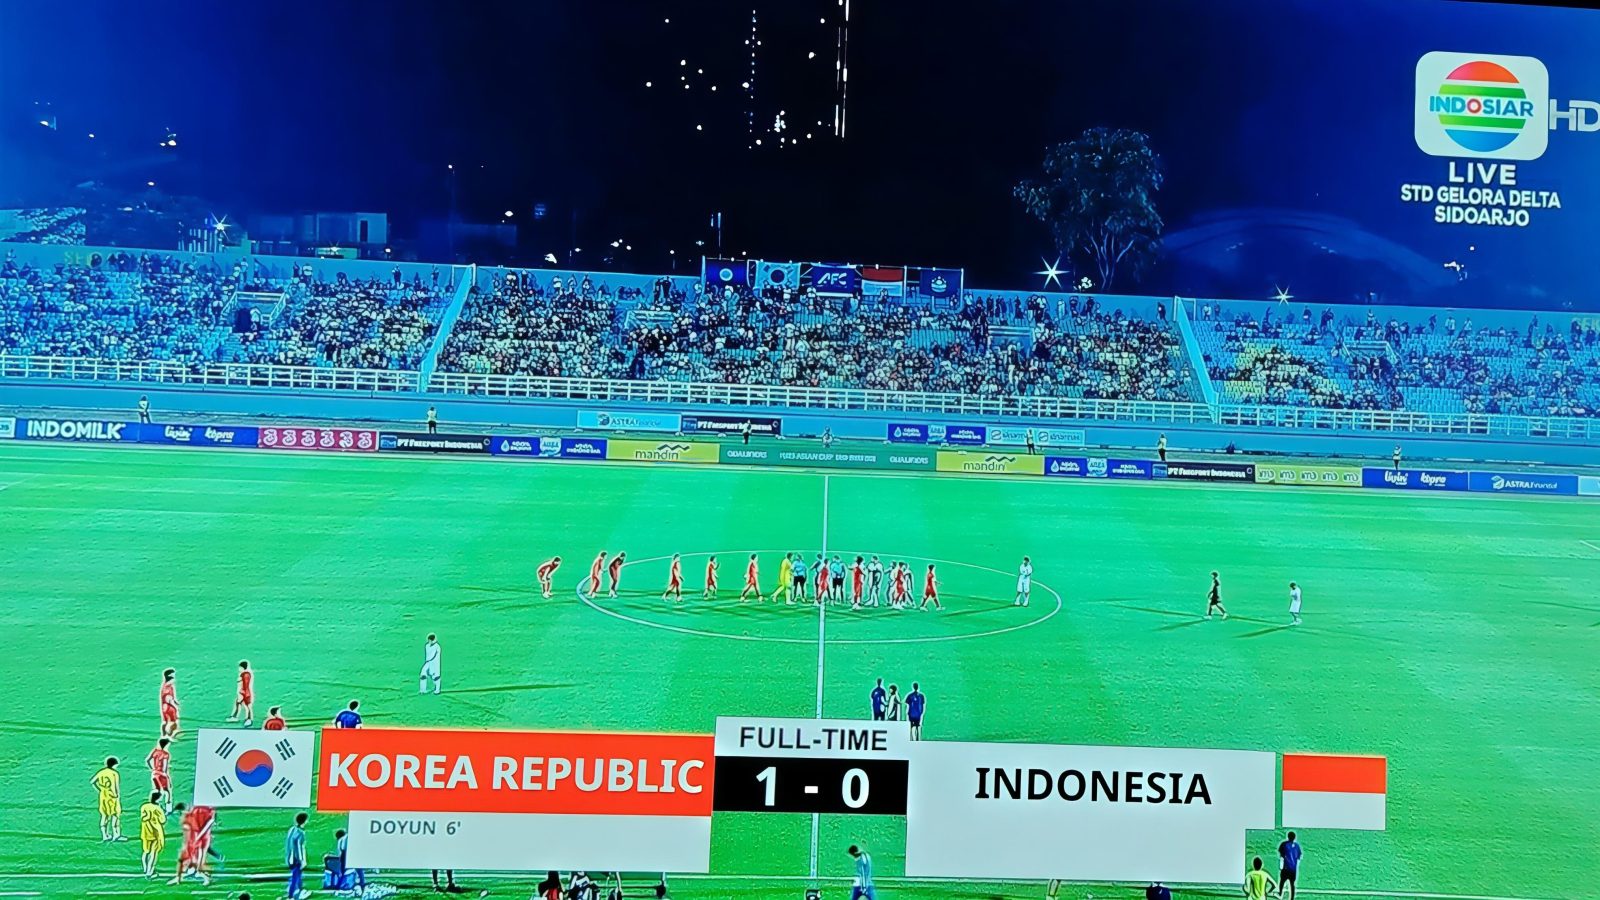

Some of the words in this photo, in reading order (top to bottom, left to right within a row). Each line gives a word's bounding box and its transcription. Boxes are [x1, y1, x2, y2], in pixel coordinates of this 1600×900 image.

[1429, 96, 1534, 117] INDOSIAR
[1549, 99, 1600, 132] HD
[1449, 161, 1516, 185] LIVE
[1401, 184, 1433, 202] STD
[1437, 186, 1506, 206] GELORA
[1509, 190, 1561, 209] DELTA
[1435, 205, 1529, 227] SIDOARJO
[817, 272, 847, 286] AFC
[27, 420, 122, 440] INDOMILK
[739, 726, 889, 752] FULL-TIME
[328, 752, 479, 791] KOREA
[492, 755, 705, 794] REPUBLIC
[755, 766, 778, 807] 1
[841, 768, 871, 809] 0
[975, 767, 1213, 805] INDONESIA
[369, 819, 437, 836] DOYUN
[446, 820, 462, 836] 6'
